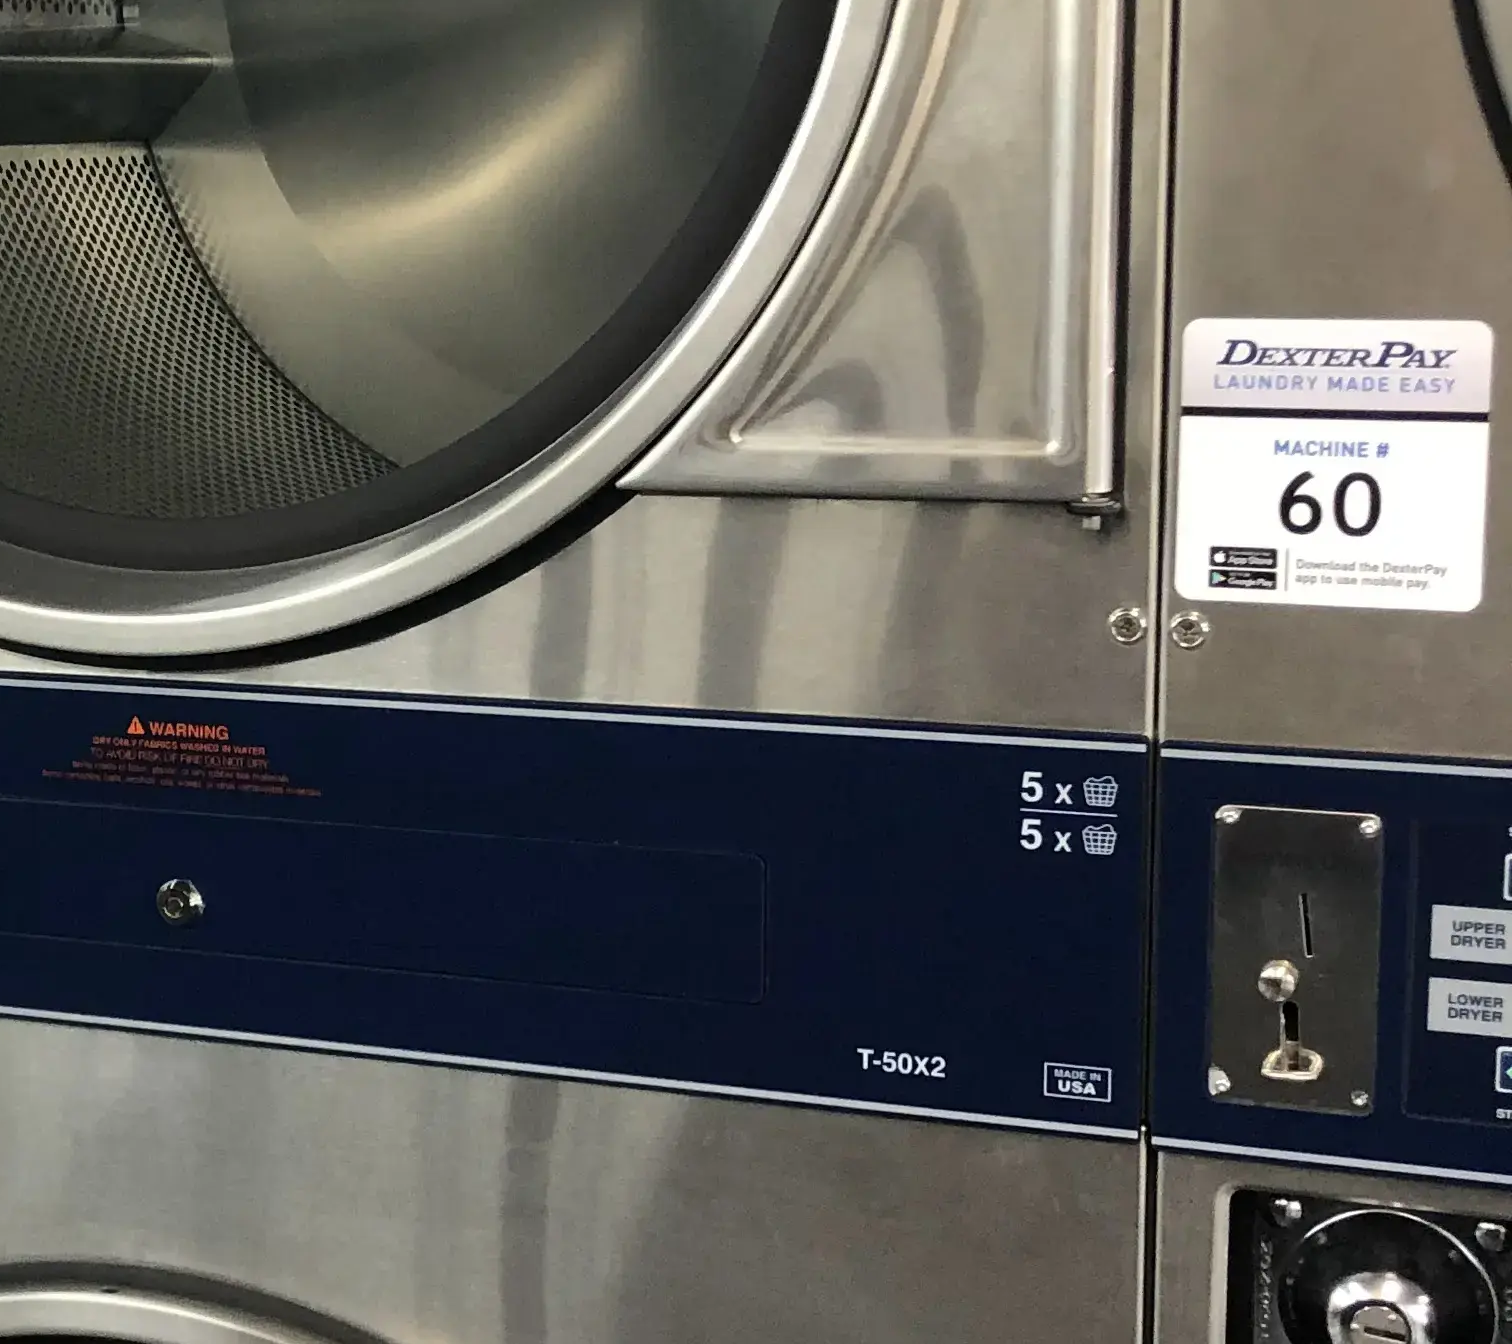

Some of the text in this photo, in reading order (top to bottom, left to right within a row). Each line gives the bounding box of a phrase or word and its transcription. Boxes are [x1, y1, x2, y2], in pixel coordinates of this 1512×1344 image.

[1213, 374, 1456, 394] LAUNDRY MADE EASY
[1273, 439, 1390, 458] MACHINE #
[1278, 471, 1382, 537] 60
[1295, 558, 1448, 578] Download the DexterPay
[1295, 574, 1318, 585] app
[1320, 573, 1333, 585] to
[1336, 576, 1358, 586] use
[1361, 575, 1403, 588] mobile
[149, 721, 230, 741] WARNING
[1019, 770, 1073, 805] 5 x
[1019, 818, 1072, 853] 5 x
[1452, 920, 1506, 935] UPPER
[1450, 935, 1506, 950] DRYER
[1447, 993, 1504, 1009] LOWER
[1447, 1007, 1503, 1023] DRYER
[856, 1047, 947, 1079] T-50X2
[1053, 1068, 1087, 1081] MADE
[1057, 1080, 1097, 1096] USA
